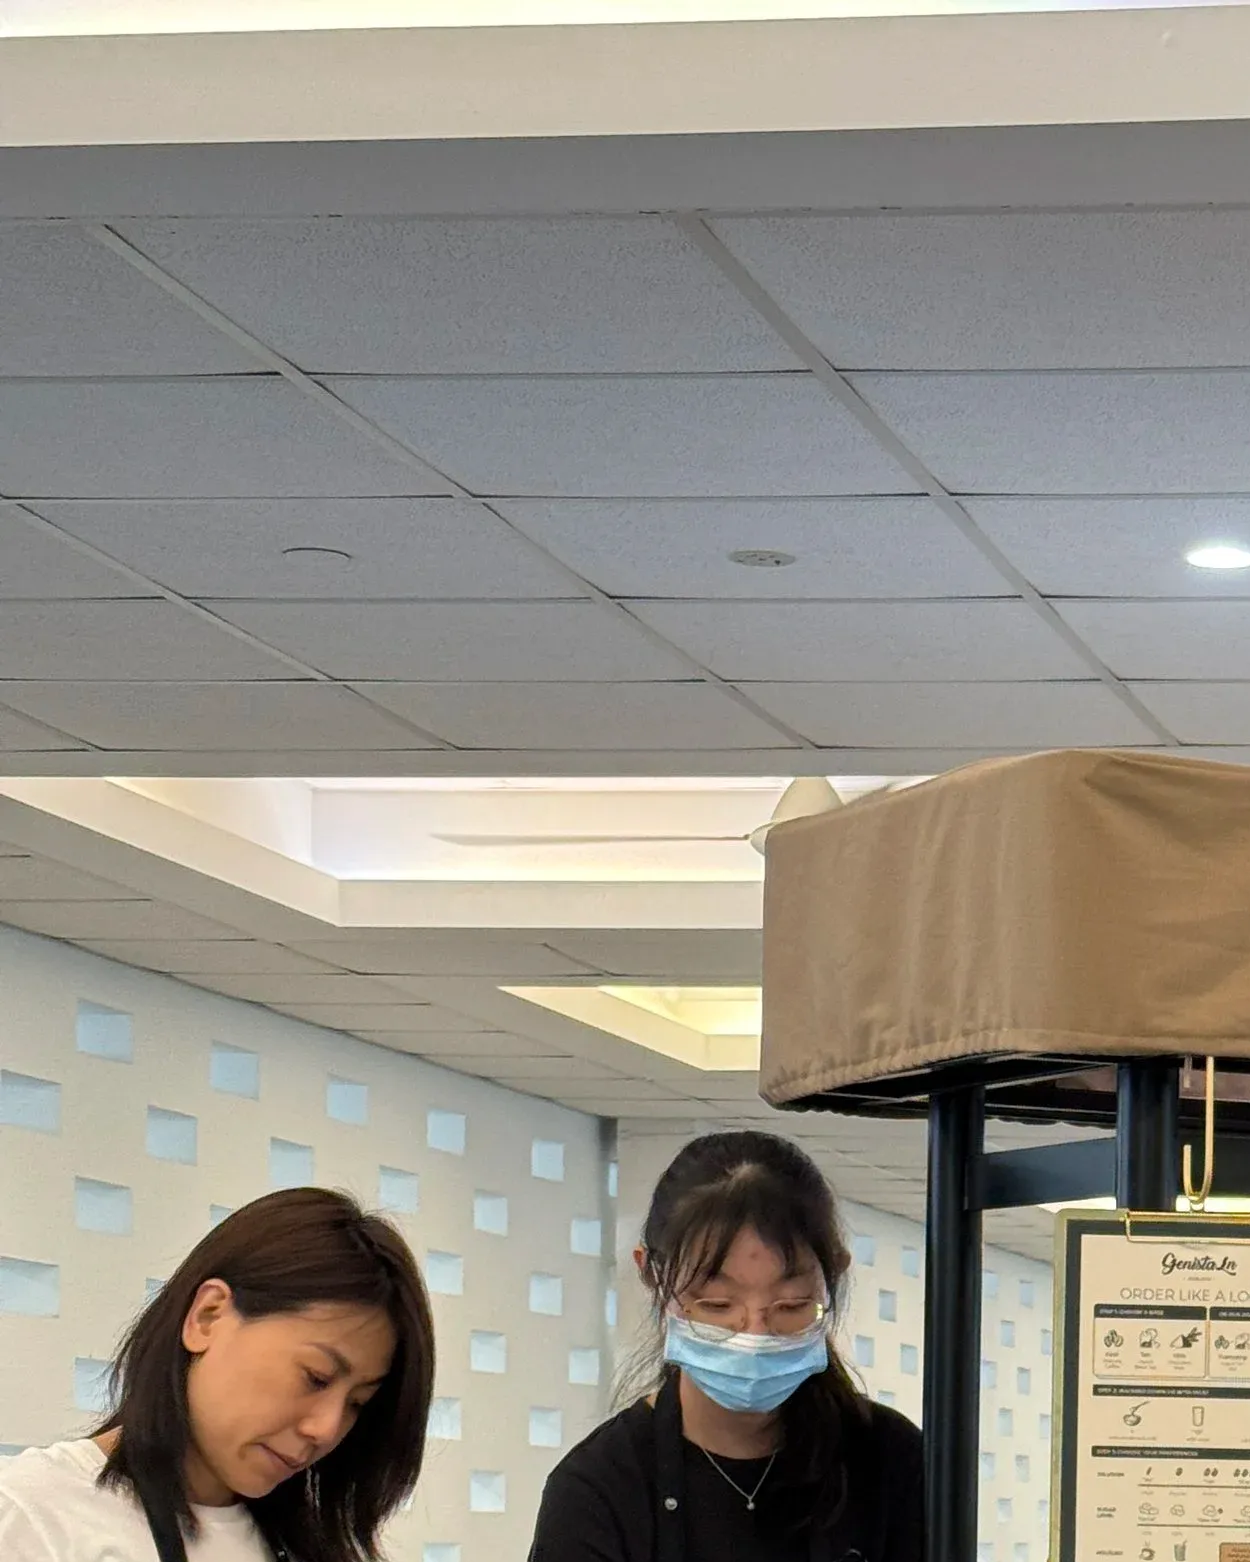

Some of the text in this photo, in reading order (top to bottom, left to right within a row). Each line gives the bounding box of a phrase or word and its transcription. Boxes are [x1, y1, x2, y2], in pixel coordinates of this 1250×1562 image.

[1161, 1252, 1216, 1276] Genista
[1119, 1287, 1176, 1301] ORDER
[1179, 1289, 1211, 1302] LIKE
[1214, 1289, 1226, 1302] A
